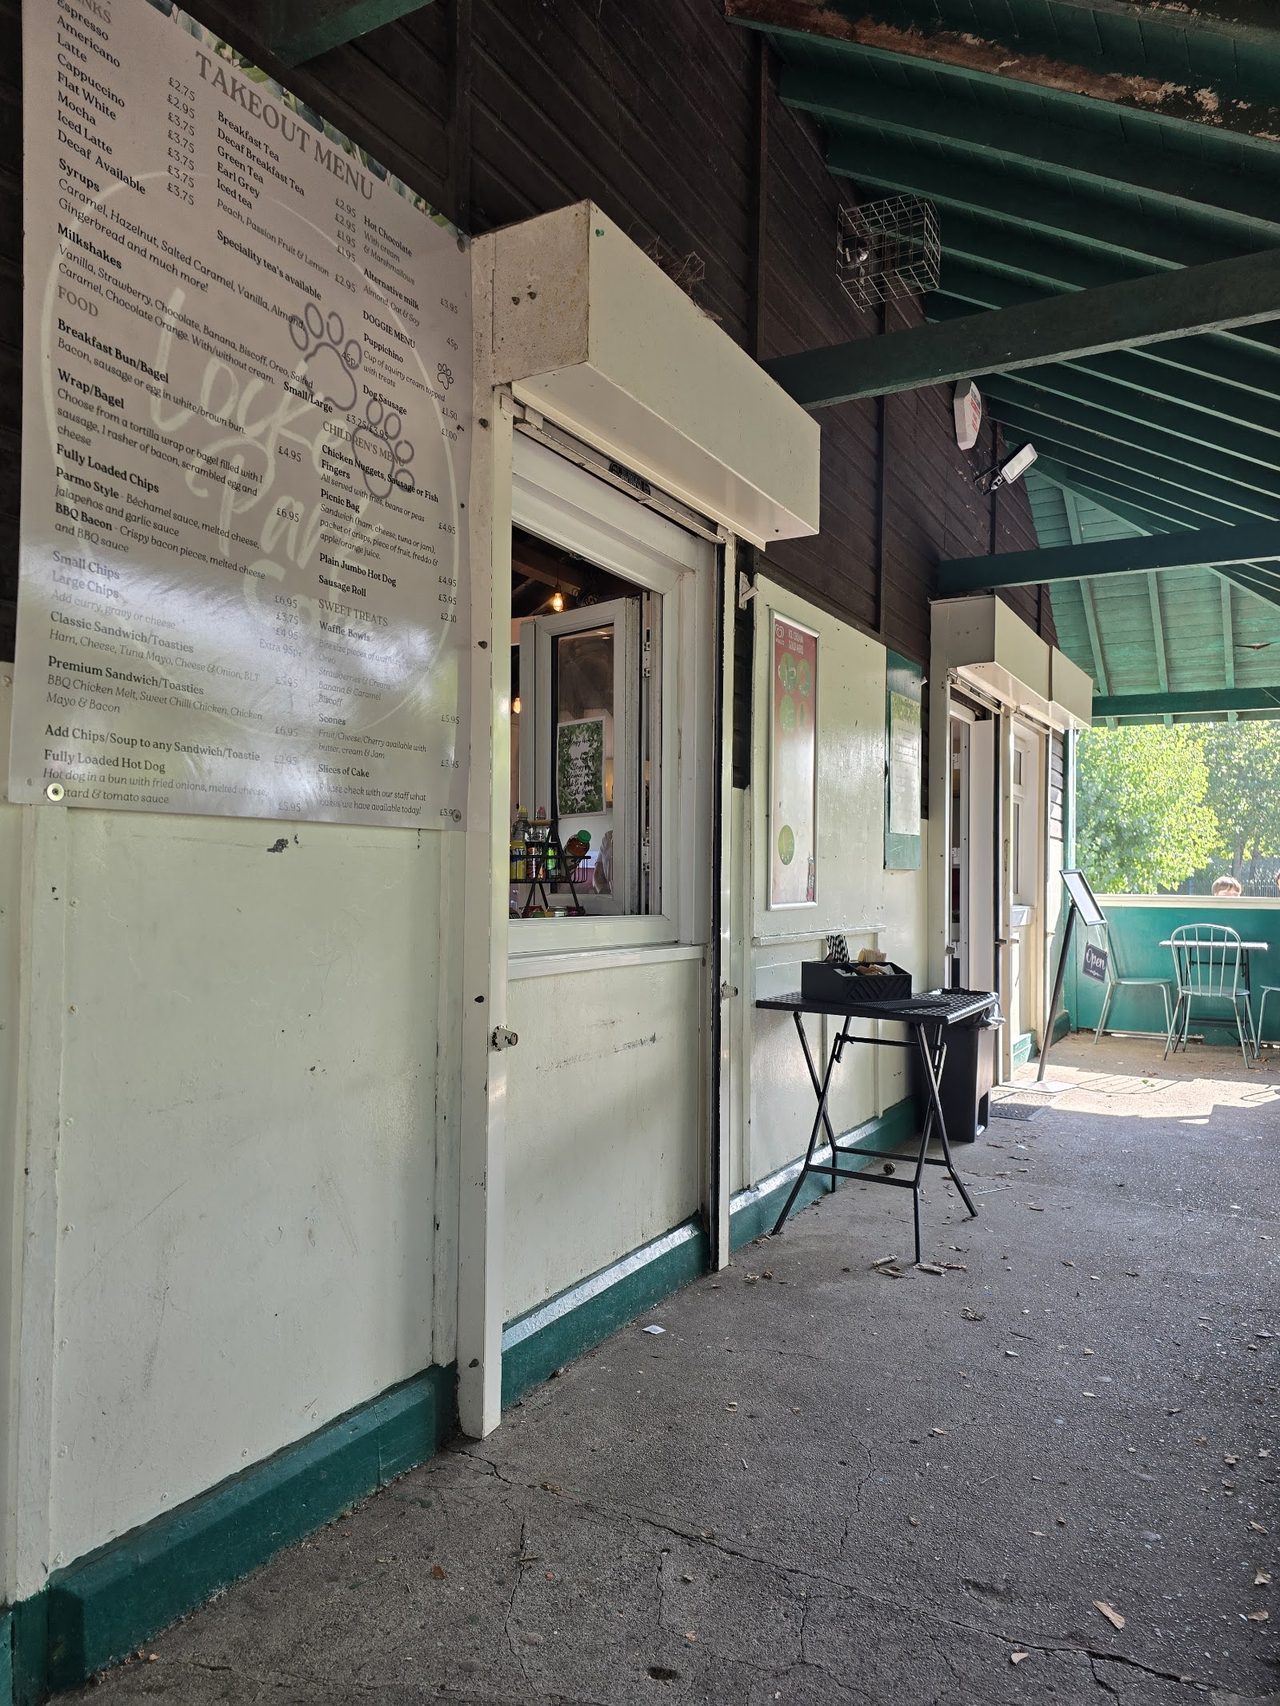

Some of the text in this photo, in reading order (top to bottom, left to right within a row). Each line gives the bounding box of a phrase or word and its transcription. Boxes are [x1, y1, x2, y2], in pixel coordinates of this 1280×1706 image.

[56, 14, 120, 67] Americano
[57, 31, 87, 62] Latte
[57, 52, 125, 107] Cappuccino
[57, 70, 116, 120] Flat White
[168, 76, 195, 101] £2.75
[57, 89, 96, 126] Mocha
[166, 93, 195, 119] £2.95
[57, 109, 112, 155] Iced Latte
[167, 111, 194, 136] £3.75
[195, 50, 373, 200] TAKEOUT MENU
[217, 110, 279, 162] Breakfast Tea
[167, 129, 194, 153] £3.75
[57, 128, 145, 194] Decaf Available
[167, 146, 194, 171] £3.75
[217, 127, 304, 196] Decaf Breakfast Tea
[217, 145, 263, 184] Green Tea
[58, 157, 99, 192] Syrups
[167, 164, 194, 188] £3.75
[217, 160, 260, 199] Earl Grey
[166, 181, 194, 205] £3.75
[216, 177, 252, 209] Iced tea
[57, 222, 121, 269] Milkshakes
[58, 197, 208, 292] Gingerbread and much more!
[363, 215, 412, 257] Hot Chocolate
[216, 229, 321, 301] Speciality tea's available
[334, 273, 356, 293] £2.95
[363, 267, 419, 310] Alternative milk
[57, 284, 98, 316] FOOD
[362, 309, 415, 348] DOGGIE MENU
[57, 317, 168, 383] Breakfast Bun/Bagel
[363, 332, 403, 363] Puppichino
[363, 349, 376, 364] Cup
[376, 359, 384, 368] of
[405, 375, 424, 391] cream
[363, 364, 395, 387] with treats
[57, 367, 124, 409] Wrap/Bagel
[283, 380, 333, 413] Small/Large
[362, 384, 407, 415] Dog Sausage
[56, 424, 91, 446] cheese
[56, 442, 159, 493] Fully Loaded Chips
[277, 445, 301, 462] £4.95
[321, 458, 350, 479] Fingers
[321, 444, 438, 503] Chicken Nuggets, Sausage or Fish
[320, 472, 328, 483] All
[353, 488, 368, 499] with
[384, 499, 403, 513] beans
[320, 488, 360, 514] Picnic Bag
[54, 484, 179, 536] jalapeños and garlic sauce
[276, 507, 299, 522] £6.95
[319, 503, 354, 523] Sandwich
[54, 522, 129, 552] and BBQ sauce
[438, 521, 455, 534] £4.95
[52, 550, 120, 580] Small Chips
[319, 552, 396, 587] Plain Jumbo Hot Dog
[51, 569, 119, 599] Large Chips
[318, 574, 366, 597] Sausage Roll
[437, 575, 456, 587] £4.95
[273, 594, 297, 609] £6.95
[318, 598, 388, 627] SWEET TREATS
[50, 610, 194, 653] Classic Sandwich/Toasties
[48, 655, 204, 695] Premium Sandwich/Toasties
[318, 712, 346, 725] Scones
[44, 723, 260, 761] Add Chips/Soup to any Sandwich/Toastie
[384, 740, 412, 750] available
[412, 744, 426, 752] with
[44, 748, 165, 774] Fully Loaded Hot Dog
[317, 763, 369, 777] Slices of Cake
[42, 767, 63, 780] Hot
[64, 769, 85, 783] dog
[86, 771, 96, 781] in
[98, 774, 105, 782] a
[107, 773, 127, 784] bun
[129, 776, 150, 786] with
[152, 777, 174, 788] fried
[207, 783, 237, 793] melted
[343, 784, 364, 796] check
[365, 787, 380, 797] with
[381, 790, 393, 798] our
[393, 791, 410, 800] staff
[409, 792, 426, 801] what
[353, 800, 421, 816] have available today!
[1086, 949, 1105, 970] Open
